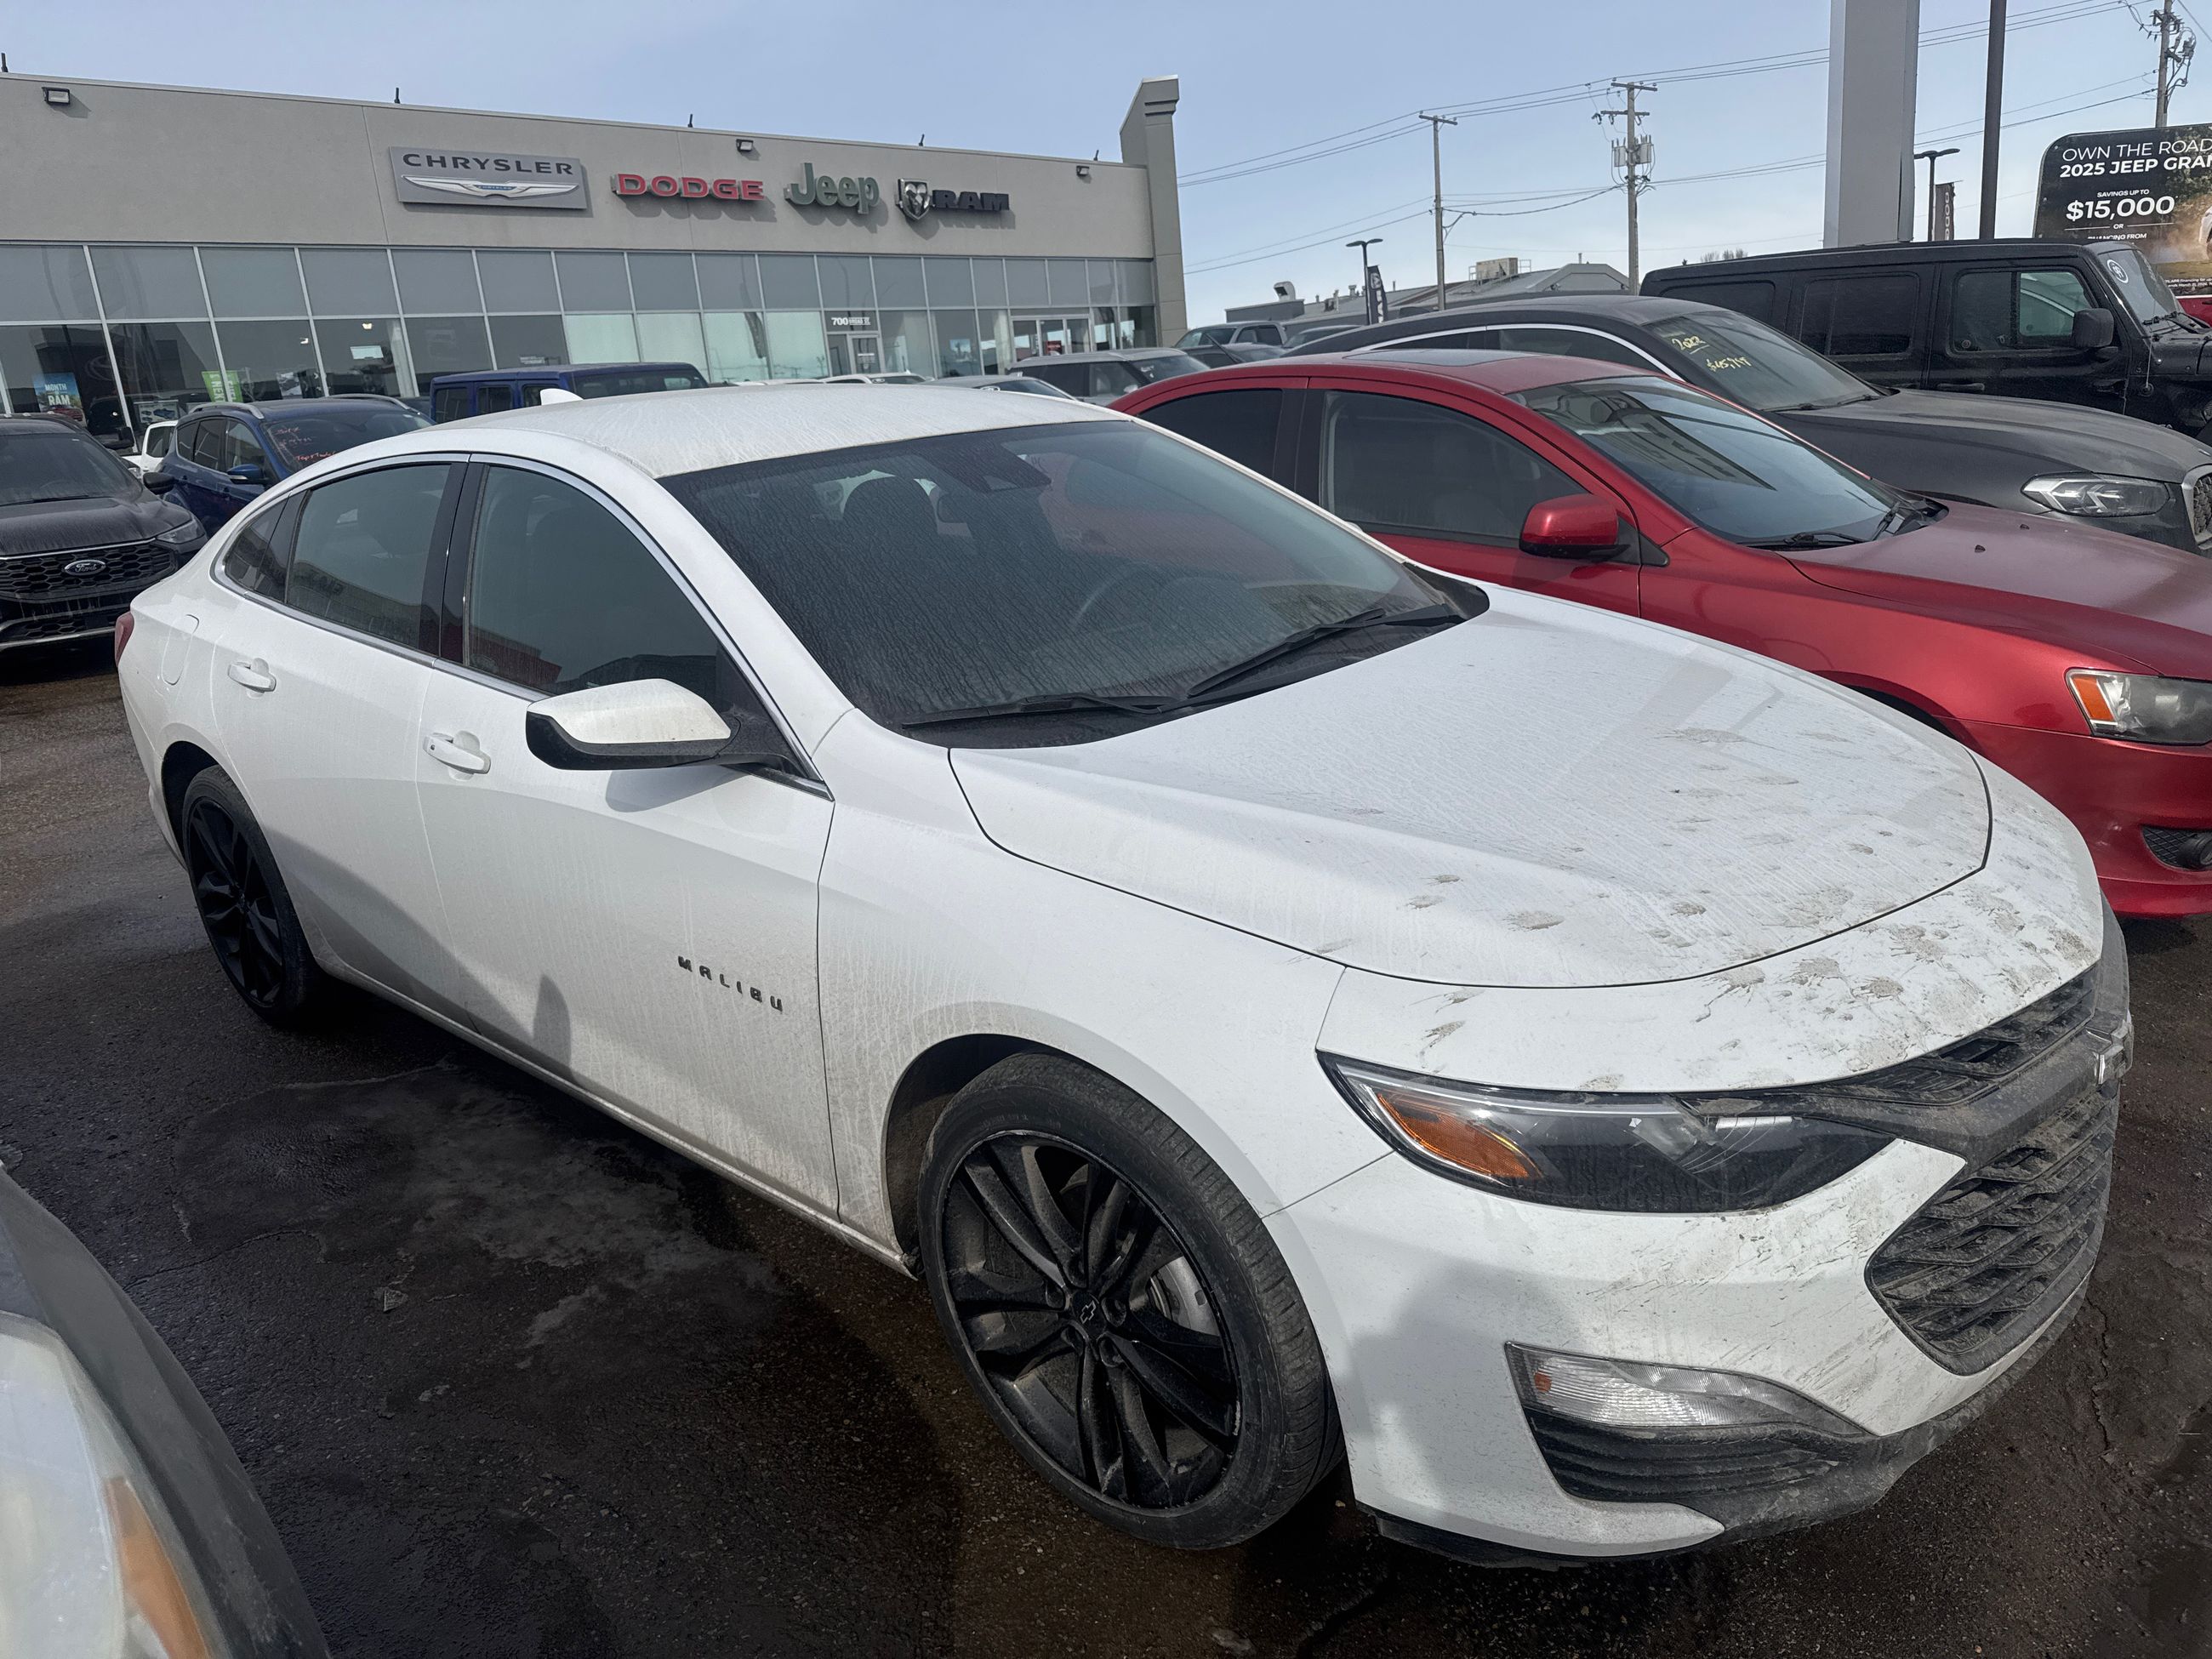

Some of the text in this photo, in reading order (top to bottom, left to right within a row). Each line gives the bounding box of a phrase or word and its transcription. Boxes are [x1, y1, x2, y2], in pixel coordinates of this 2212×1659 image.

[2062, 138, 2212, 162] OWN THE ROAD
[402, 153, 573, 175] CHRYSLER
[2060, 162, 2105, 178] 2025
[2109, 158, 2158, 174] JEEP
[616, 173, 765, 201] DODGE
[786, 162, 880, 214] Jeep
[932, 189, 1010, 211] RAM
[2066, 196, 2175, 222] $15,000
[831, 317, 848, 326] 700
[44, 383, 68, 391] MONTH
[48, 395, 71, 406] RAM
[75, 562, 97, 573] Ford
[677, 955, 783, 1012] MALIBU
